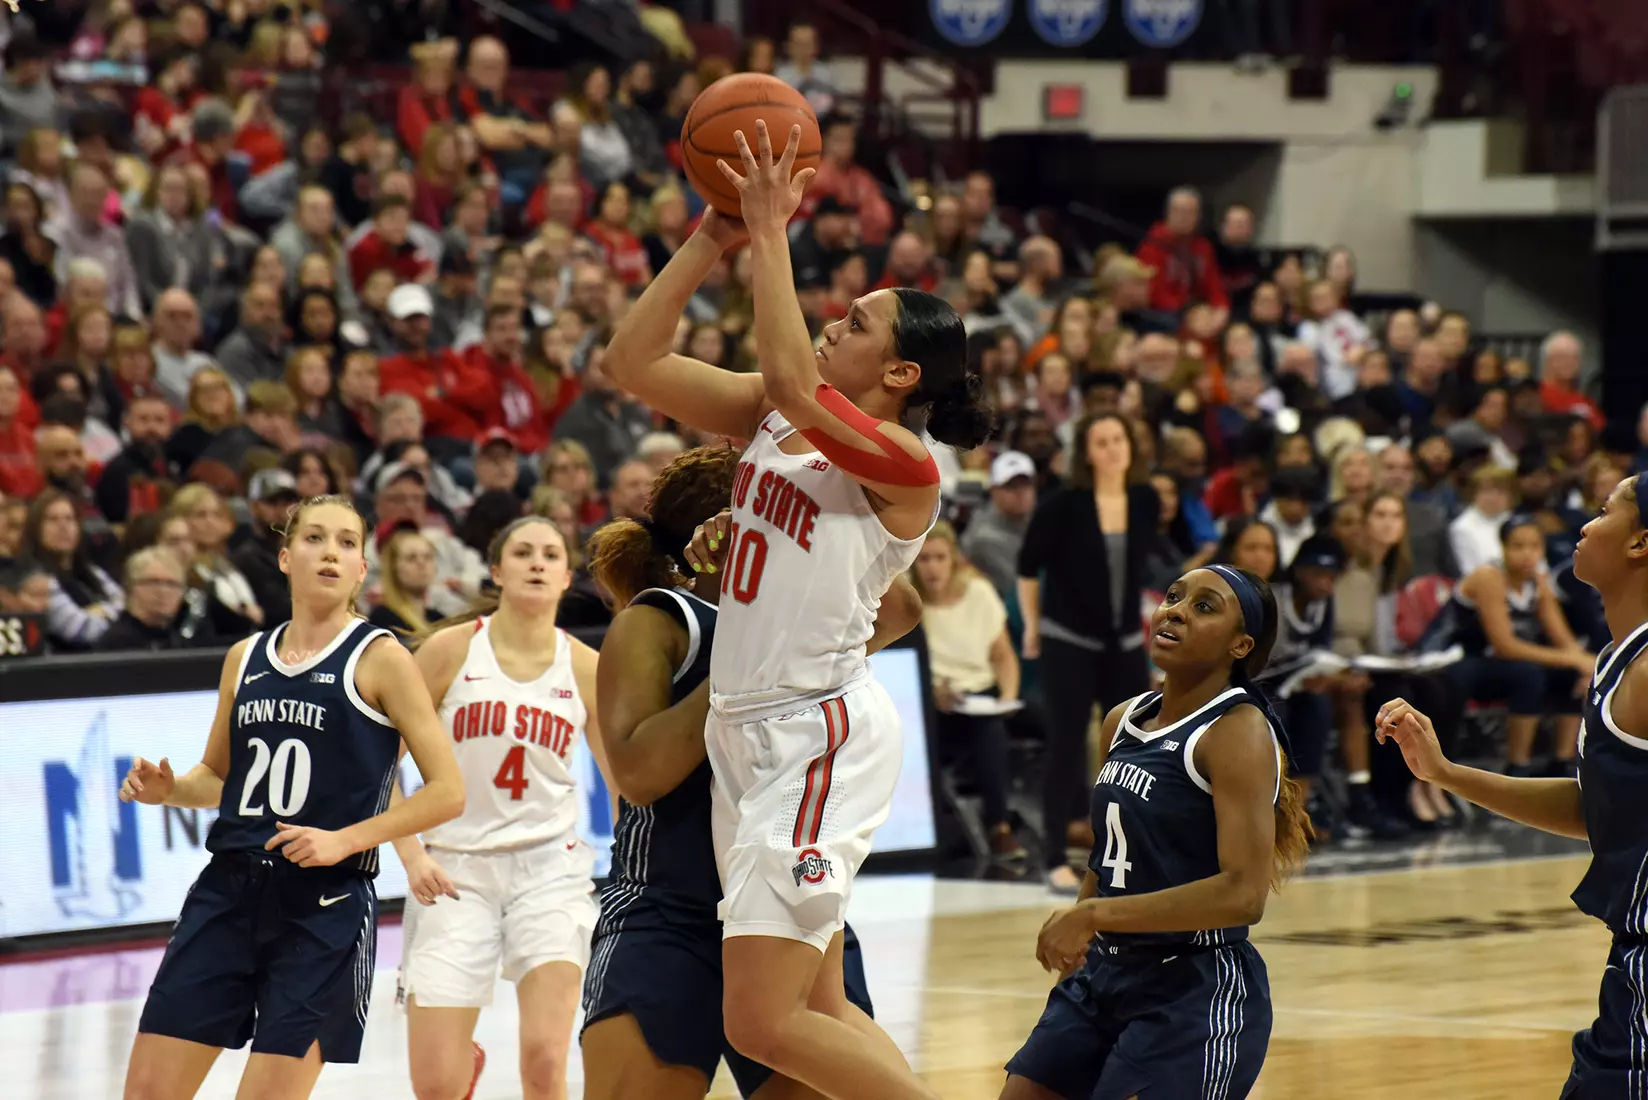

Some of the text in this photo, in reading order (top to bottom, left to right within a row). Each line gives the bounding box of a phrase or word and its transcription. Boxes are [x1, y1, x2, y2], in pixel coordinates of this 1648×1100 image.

[752, 470, 821, 553] STATE
[721, 522, 769, 605] 10
[238, 699, 326, 731] PENN STATE
[453, 700, 574, 759] OHIO STATE
[239, 737, 311, 817] 20
[492, 745, 529, 801] 4
[1094, 760, 1157, 802] ENN STATE
[1101, 802, 1132, 889] 4
